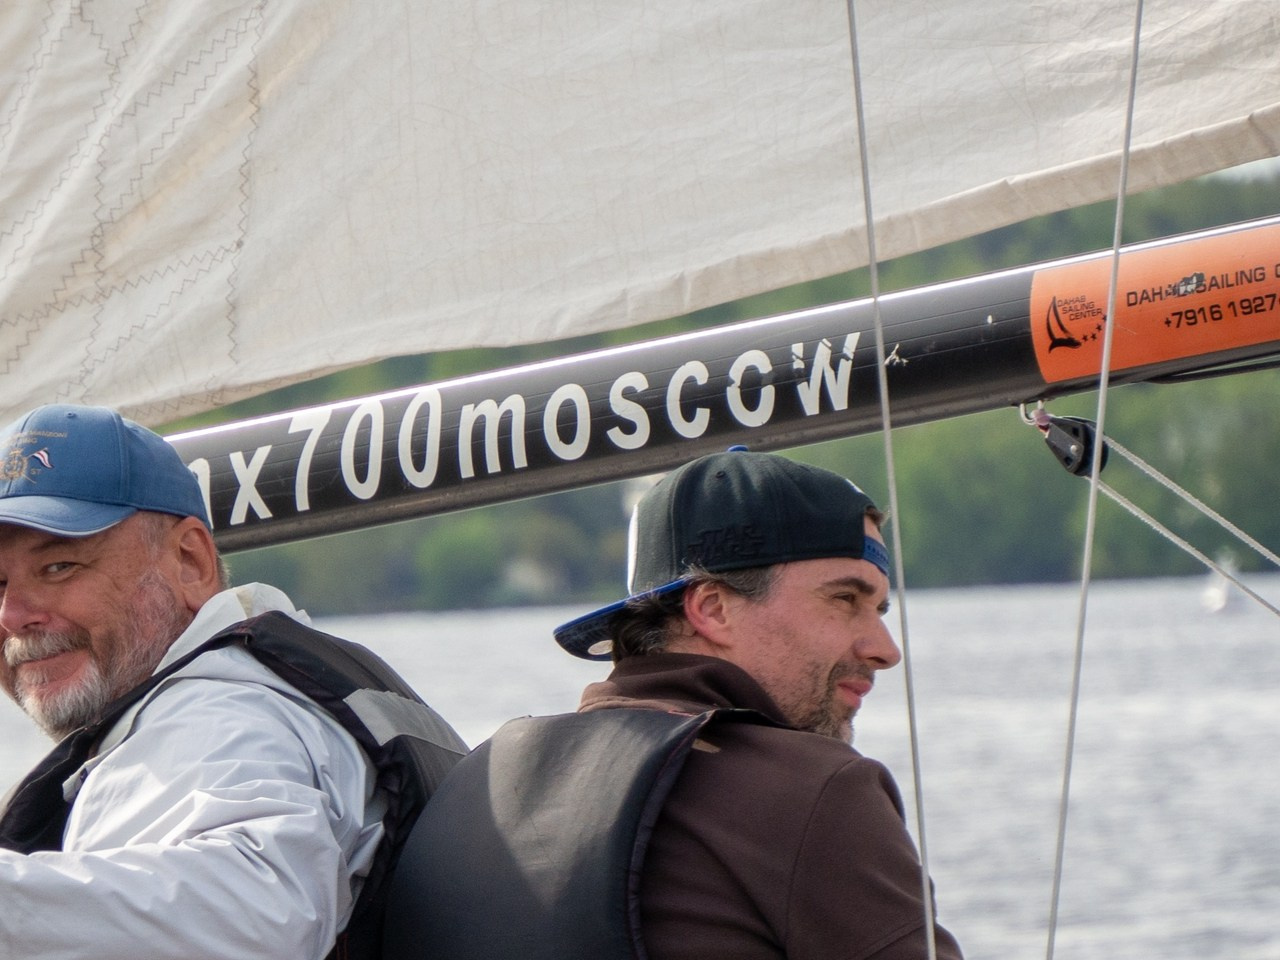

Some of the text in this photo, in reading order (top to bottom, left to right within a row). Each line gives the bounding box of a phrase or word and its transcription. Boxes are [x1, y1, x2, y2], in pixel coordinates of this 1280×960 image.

[1126, 280, 1188, 307] DAH
[1062, 301, 1095, 315] SAILING
[1069, 308, 1102, 321] CENTER
[1165, 293, 1280, 329] +7916 1927
